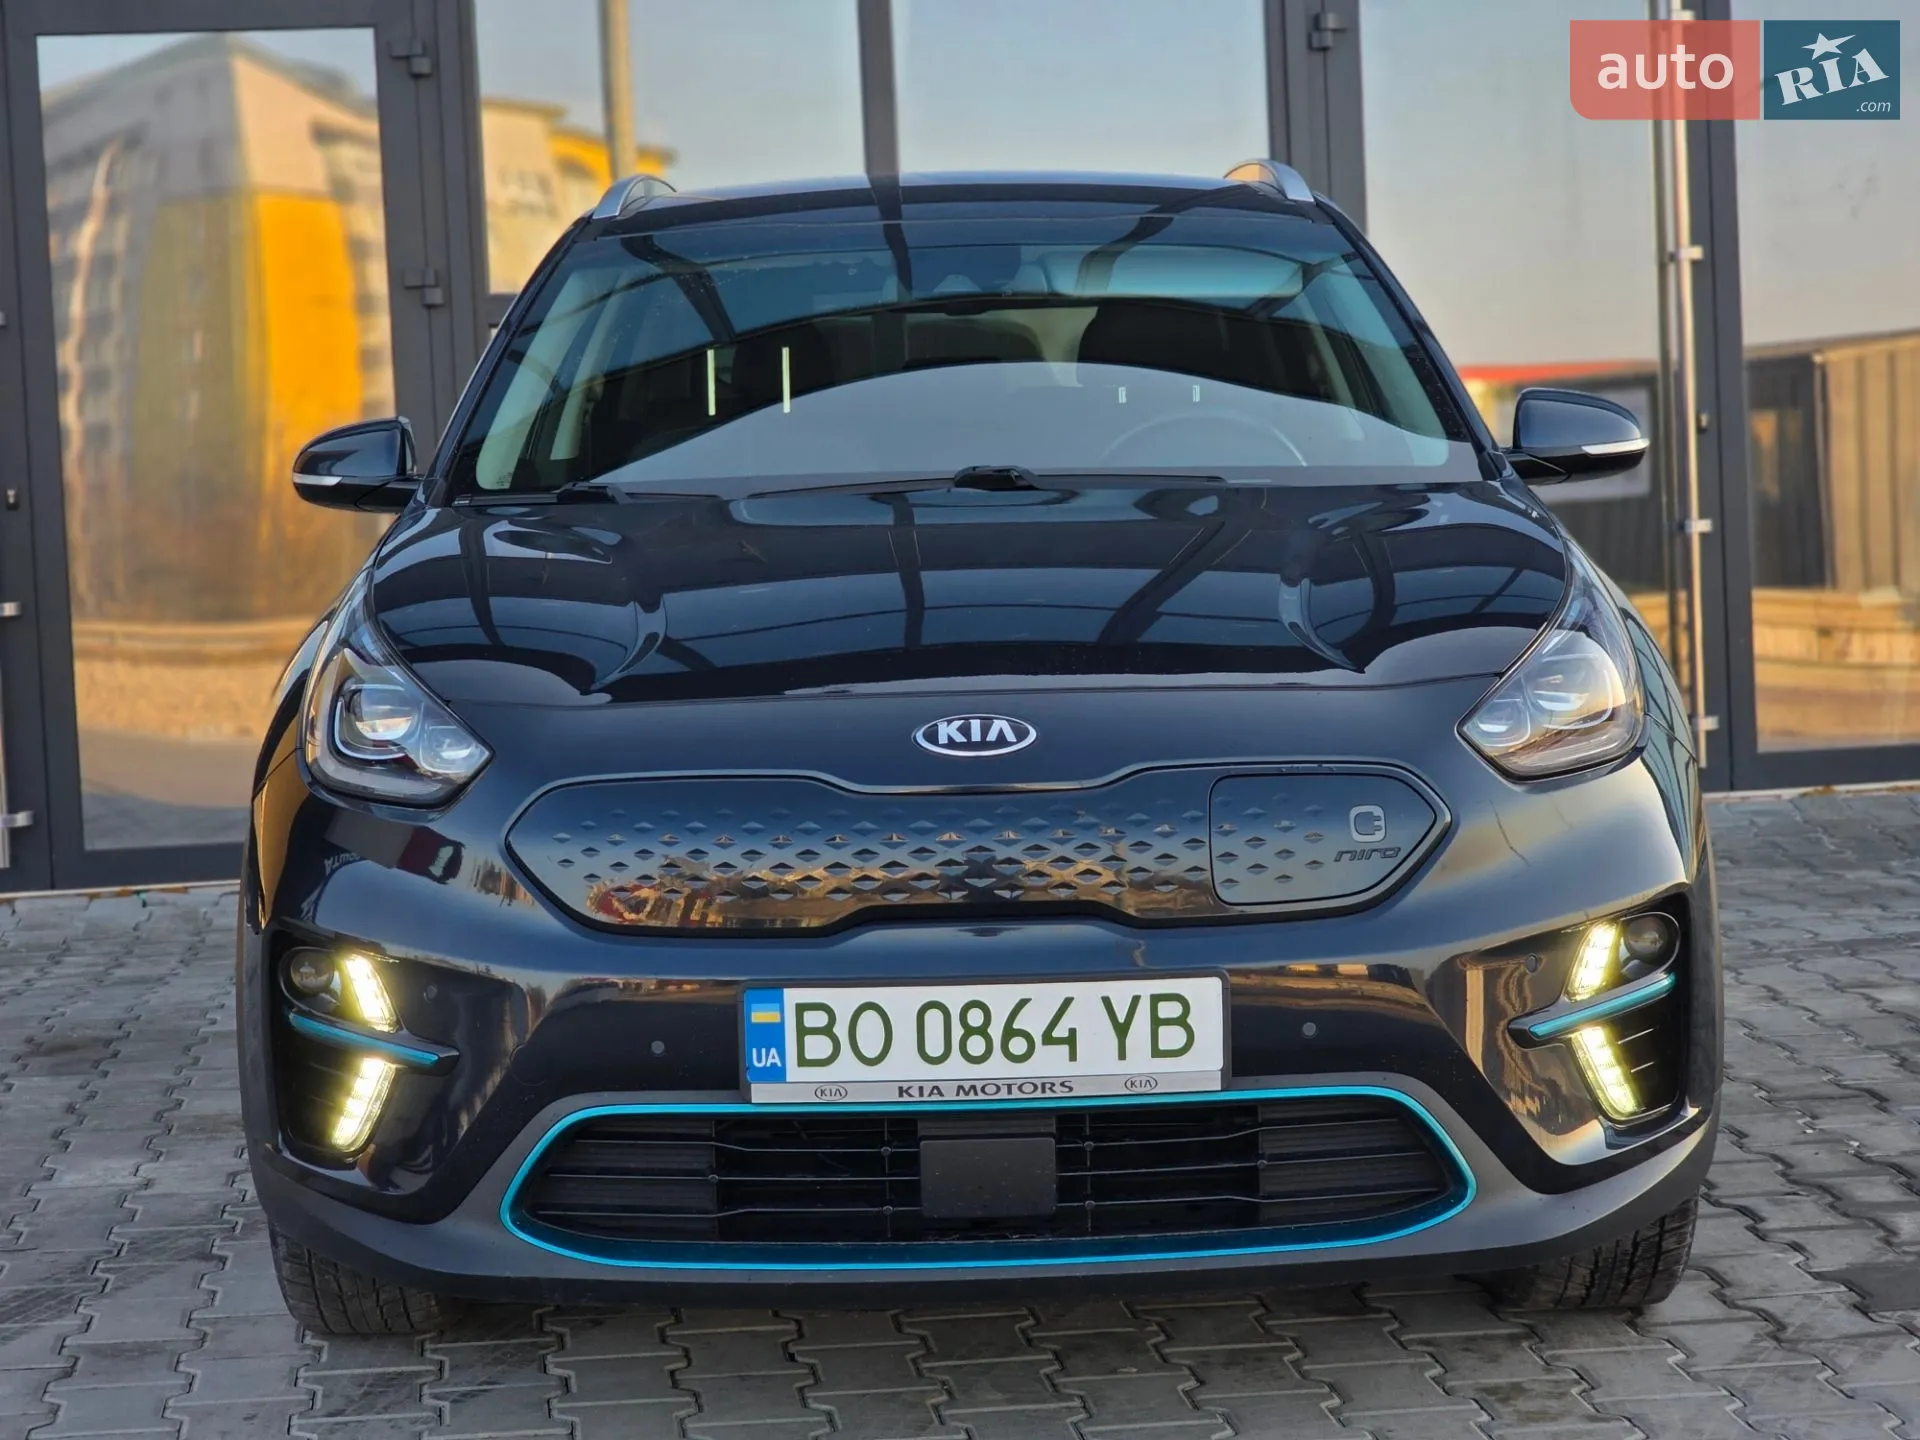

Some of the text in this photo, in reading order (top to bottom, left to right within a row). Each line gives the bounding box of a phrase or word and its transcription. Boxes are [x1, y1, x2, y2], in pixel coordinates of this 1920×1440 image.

[1333, 847, 1401, 862] niro
[795, 992, 1195, 1067] BO 0864 YB
[752, 1047, 782, 1067] UA
[898, 1079, 1074, 1099] KIA MOTORS
